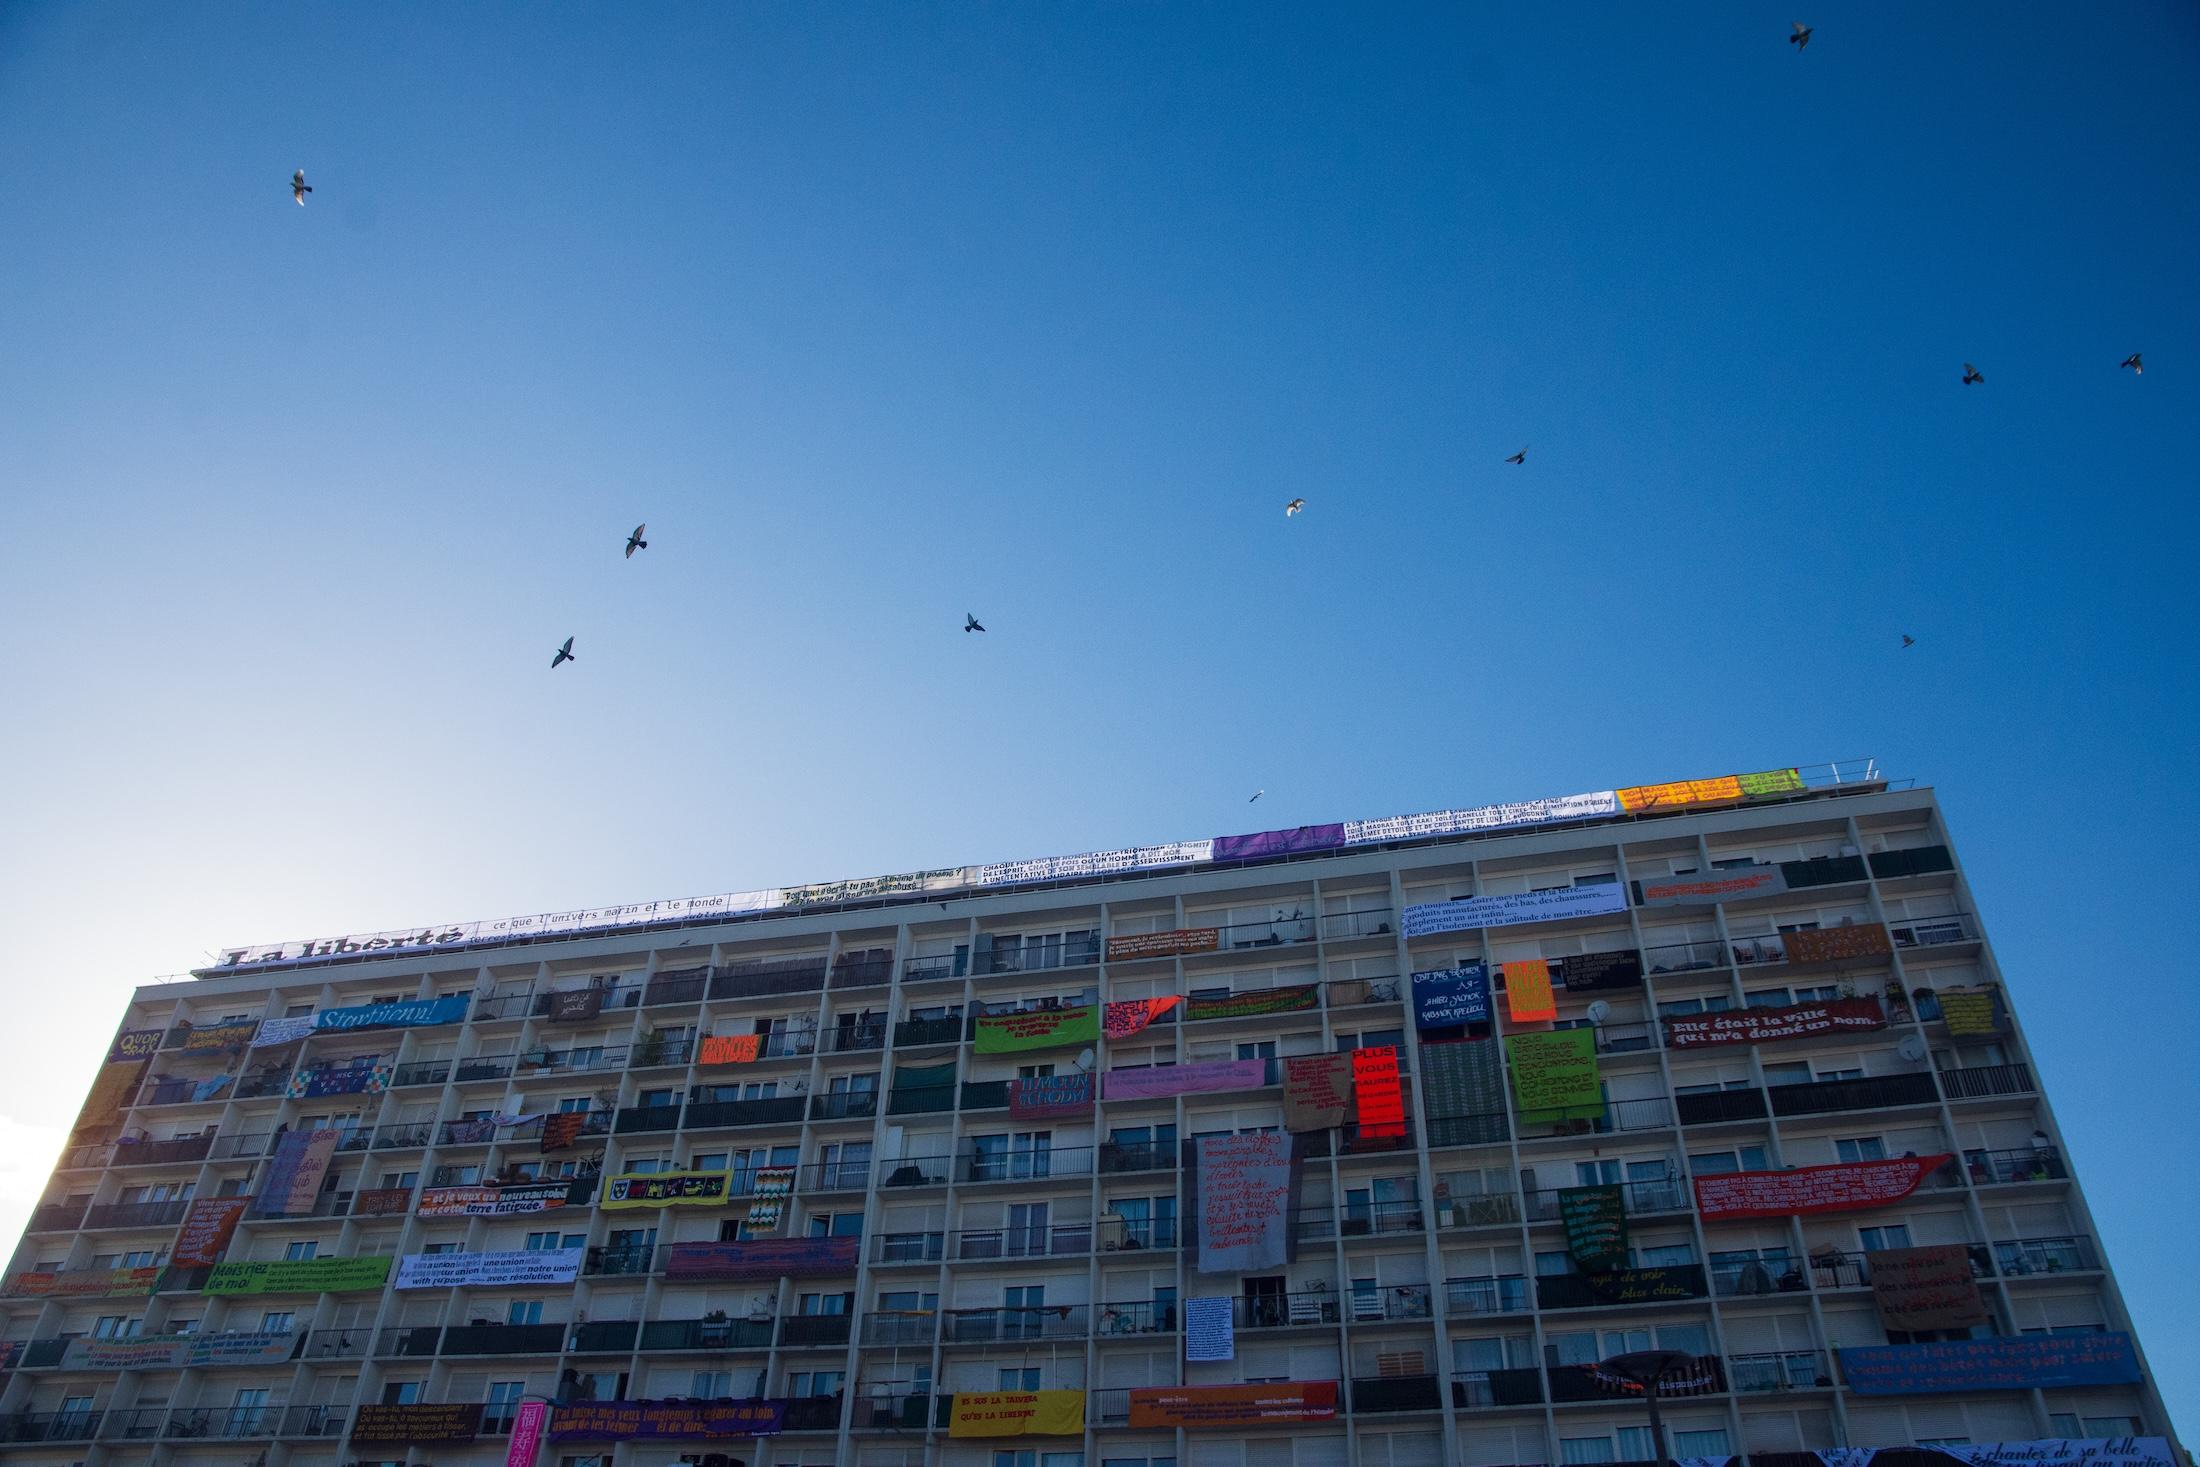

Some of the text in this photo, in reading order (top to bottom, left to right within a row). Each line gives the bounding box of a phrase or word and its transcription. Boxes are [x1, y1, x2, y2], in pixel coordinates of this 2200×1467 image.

[1495, 894, 1513, 903] mes
[1514, 891, 1538, 904] pieds
[1503, 901, 1519, 910] des
[1538, 896, 1554, 906] des
[493, 921, 506, 930] ce
[511, 916, 532, 929] que
[603, 906, 638, 918] marin
[643, 902, 659, 912] et
[667, 900, 681, 910] le
[686, 896, 723, 908] monde
[1454, 914, 1466, 922] un
[1495, 916, 1504, 925] la
[1505, 912, 1540, 924] solitude
[1540, 912, 1552, 920] de
[1553, 909, 1574, 919] mon
[221, 927, 465, 967] La liberté
[1671, 1009, 1828, 1034] Elle était la ville
[1675, 1016, 1878, 1046] qui m'a donné un nom.
[1352, 1047, 1394, 1060] PLUS
[1355, 1062, 1396, 1075] VOUS
[498, 1189, 543, 1203] nouveau
[465, 1202, 494, 1214] terre
[483, 1259, 500, 1267] une
[500, 1258, 525, 1267] union
[527, 1265, 552, 1273] notre
[553, 1264, 578, 1273] union
[213, 1264, 243, 1277] Mais
[208, 1277, 224, 1290] de
[411, 1276, 432, 1286] with
[485, 1274, 509, 1283] avec
[990, 1396, 1002, 1405] LA
[2054, 1441, 2073, 1459] de
[2080, 1446, 2098, 1460] sa
[2104, 1436, 2140, 1456] belle
